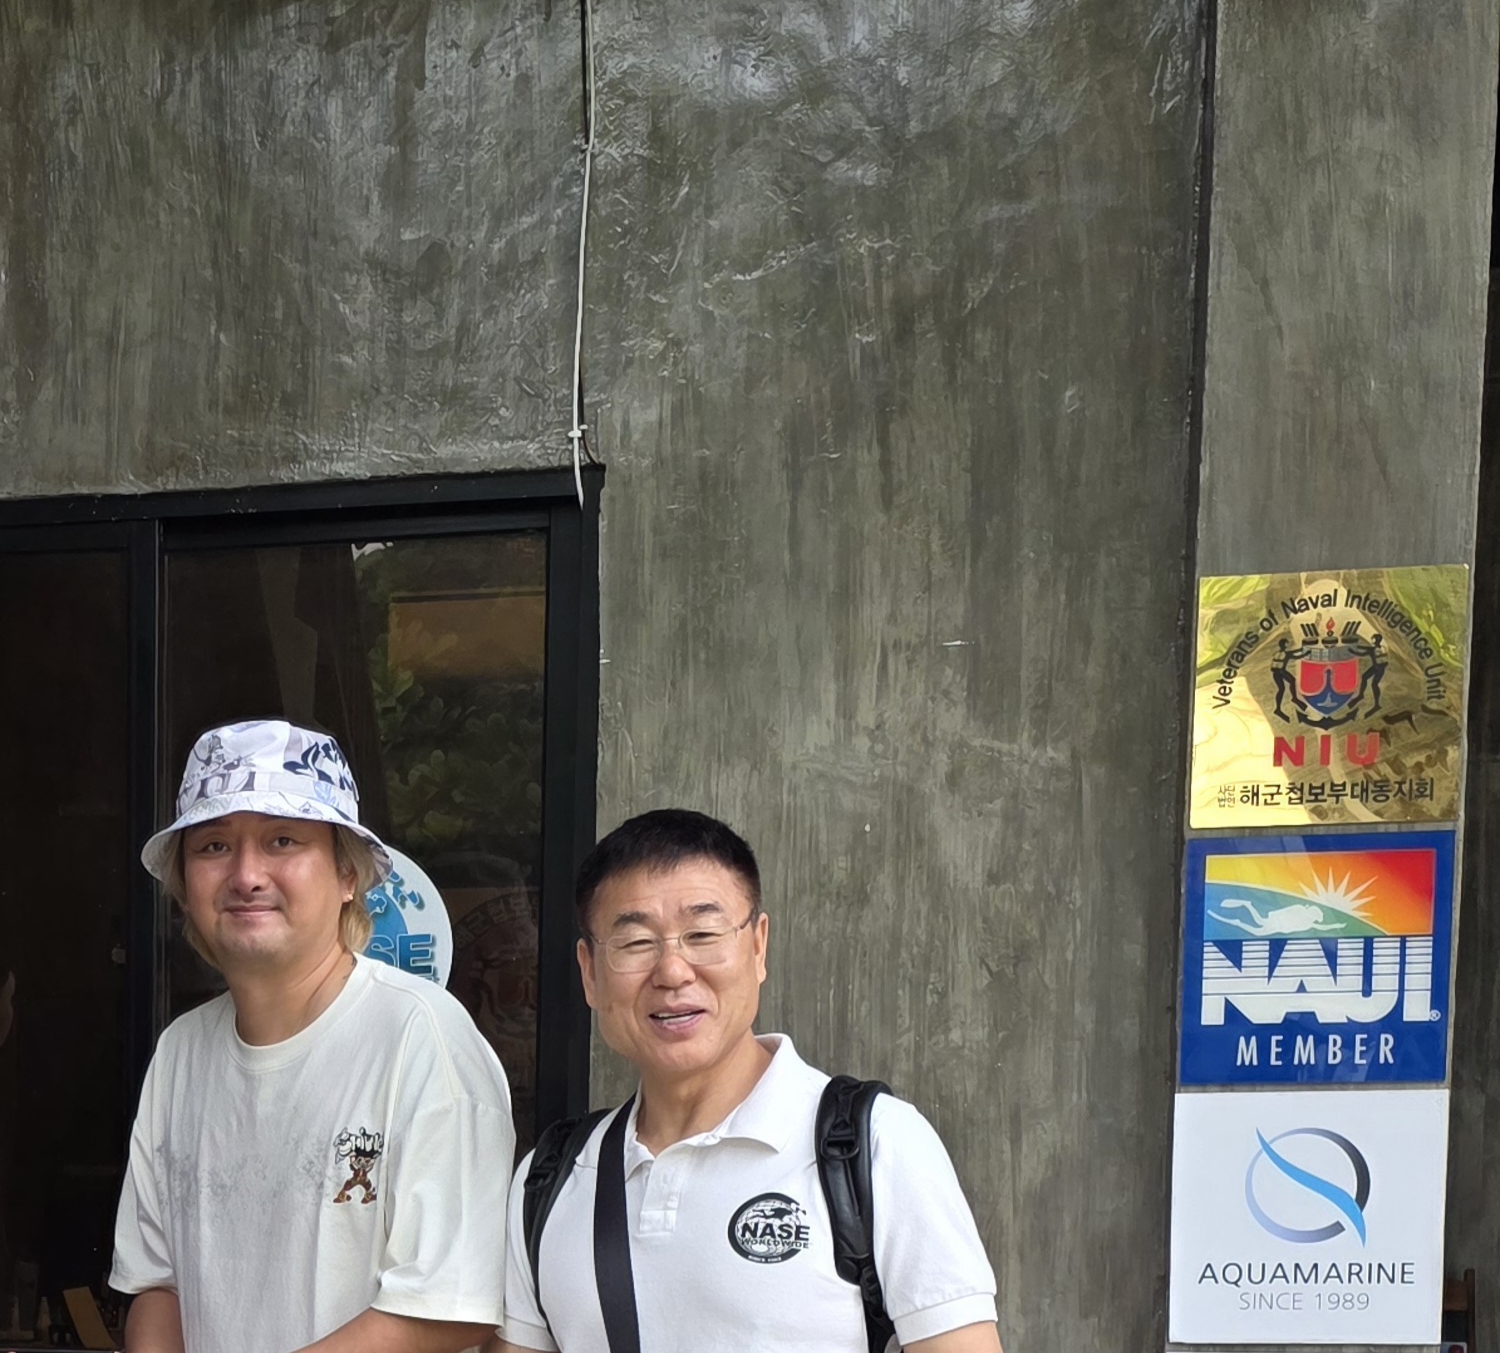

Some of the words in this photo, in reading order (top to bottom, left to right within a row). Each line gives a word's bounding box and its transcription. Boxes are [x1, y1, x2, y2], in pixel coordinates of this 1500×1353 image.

[1212, 629, 1261, 710] Veterans
[1258, 608, 1280, 633] of
[1281, 588, 1338, 620] Naval
[1344, 588, 1435, 661] Intelligence
[1424, 662, 1447, 702] Unit
[1273, 732, 1381, 768] NIU
[1239, 777, 1435, 807] 해군첩보부대동지회
[1201, 937, 1434, 1026] NAUI
[1236, 1033, 1394, 1066] MEMBER
[740, 1222, 811, 1241] NASE
[741, 1239, 810, 1250] WORLDWIDE
[1197, 1262, 1415, 1288] AQUAMARINE
[1239, 1292, 1303, 1310] SINCE
[1314, 1292, 1370, 1311] 1989
